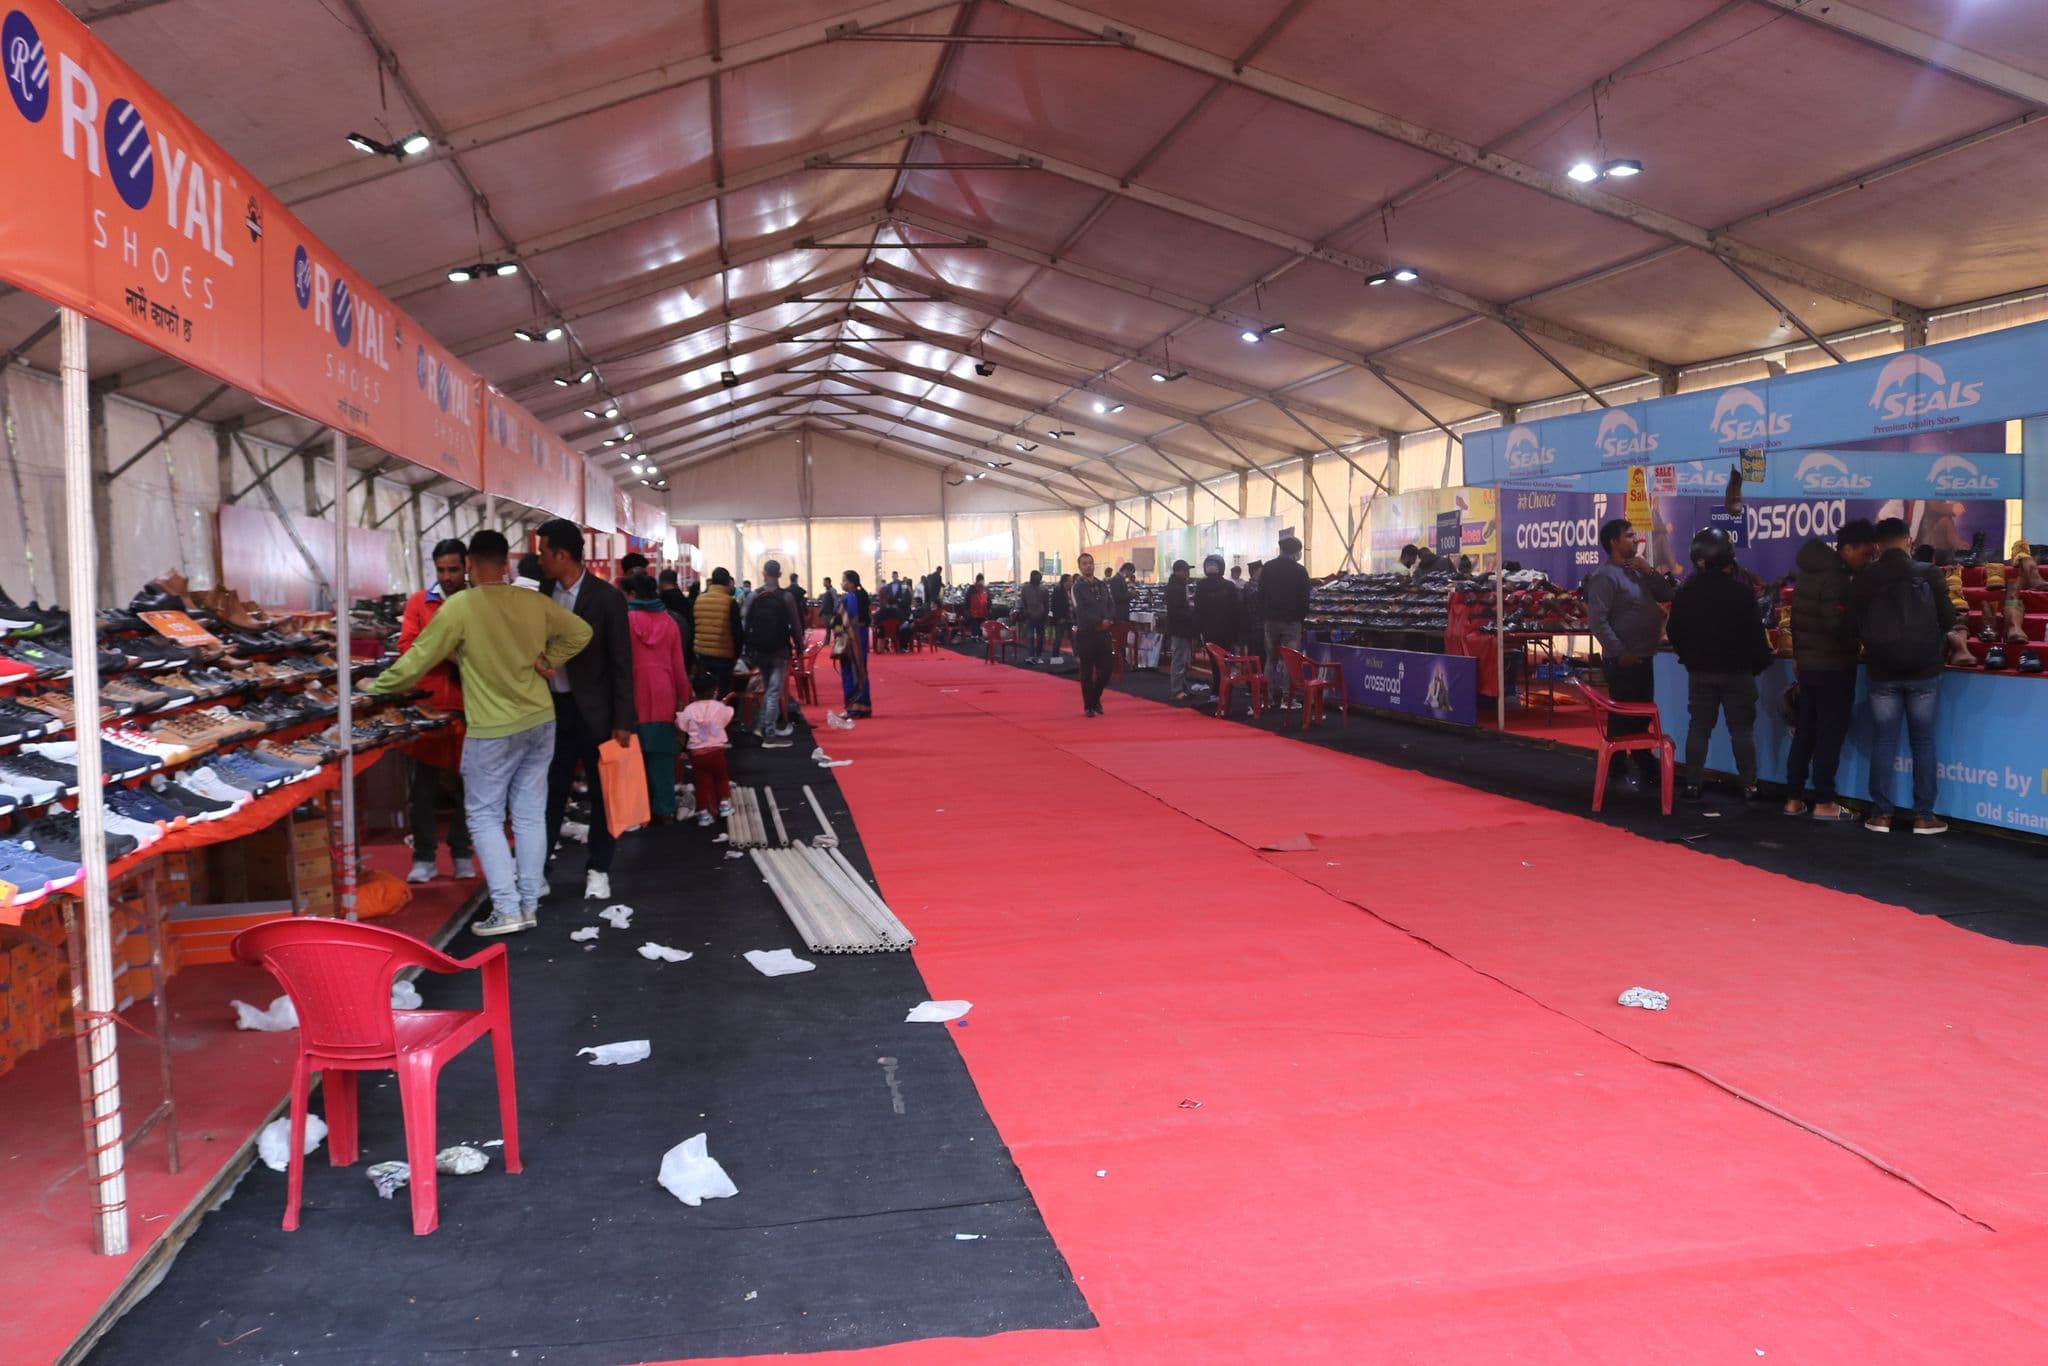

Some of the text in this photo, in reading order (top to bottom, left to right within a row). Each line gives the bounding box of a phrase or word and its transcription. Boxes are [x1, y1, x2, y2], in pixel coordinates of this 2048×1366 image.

[60, 52, 234, 267] ROYAL
[93, 208, 214, 309] SHOES
[314, 266, 390, 371] ROYAL
[326, 352, 380, 404] SHOES
[1880, 381, 1984, 421] SEALS
[1717, 412, 1793, 444] SEALS
[1602, 431, 1660, 459] SEALS
[1677, 471, 1729, 485] EALS
[1803, 473, 1873, 489] SEALS
[1516, 506, 1600, 550] crossroad
[1575, 551, 1599, 565] SHOES
[2004, 766, 2033, 797] by
[1976, 802, 2003, 821] Old
